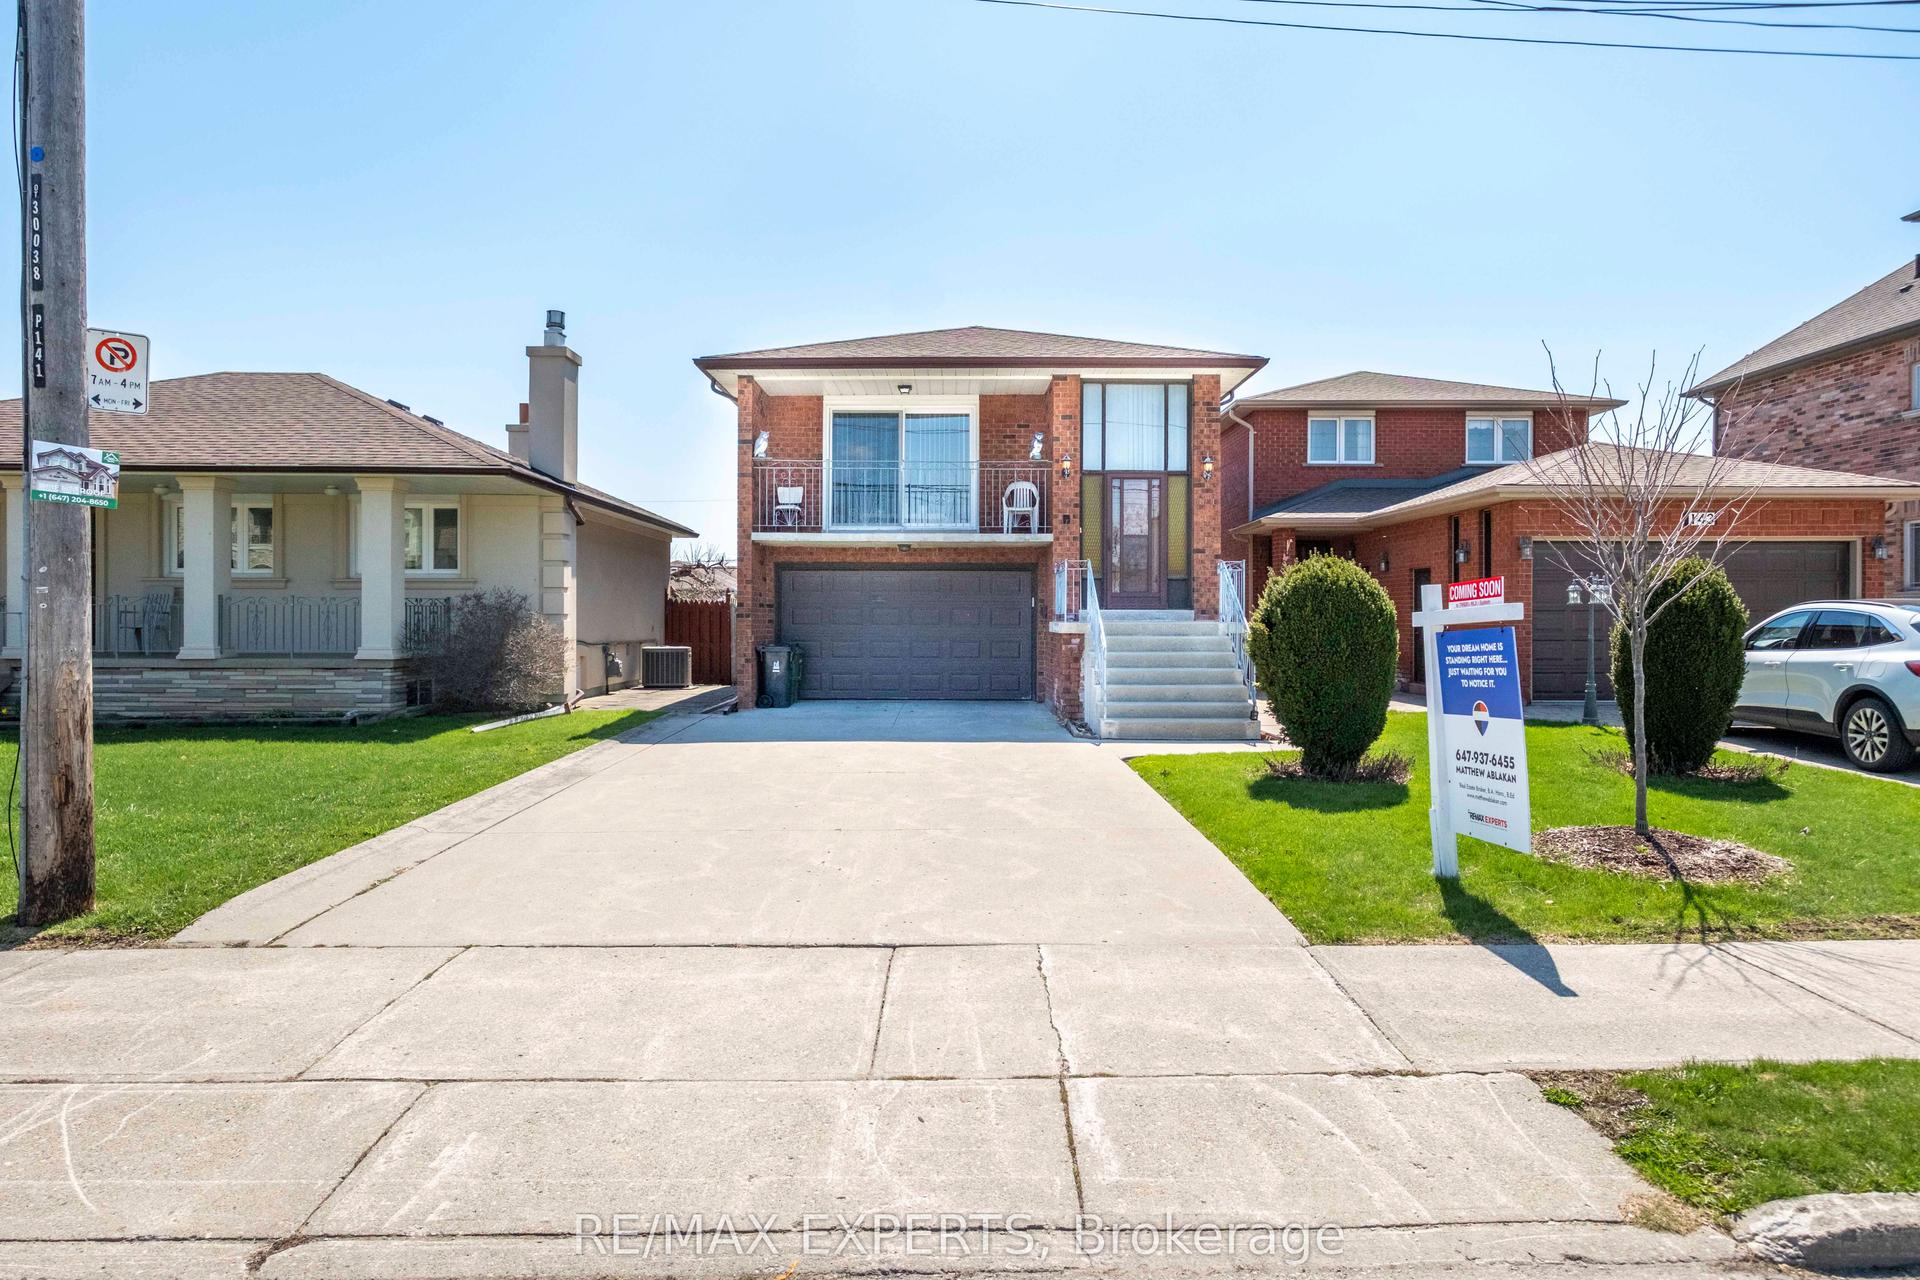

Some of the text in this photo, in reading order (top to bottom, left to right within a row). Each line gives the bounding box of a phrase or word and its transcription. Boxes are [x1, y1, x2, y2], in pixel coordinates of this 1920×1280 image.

[120, 378, 127, 389] 4
[48, 494, 70, 503] (647)
[71, 496, 109, 506] 204-8650
[1450, 580, 1501, 601] COMING SOON
[1447, 642, 1503, 653] YOUR DREAM HOME IS
[1445, 656, 1471, 665] STANDING
[1471, 656, 1488, 664] RIGHT
[1448, 667, 1507, 678] JUST WAITING FOR YOU
[1461, 679, 1469, 688] TO
[1469, 679, 1488, 688] NOTICE
[1456, 749, 1515, 769] 647-937-6455
[1456, 766, 1516, 783] MATTHEW ABLAKAN
[1485, 816, 1507, 828] EXPERTS
